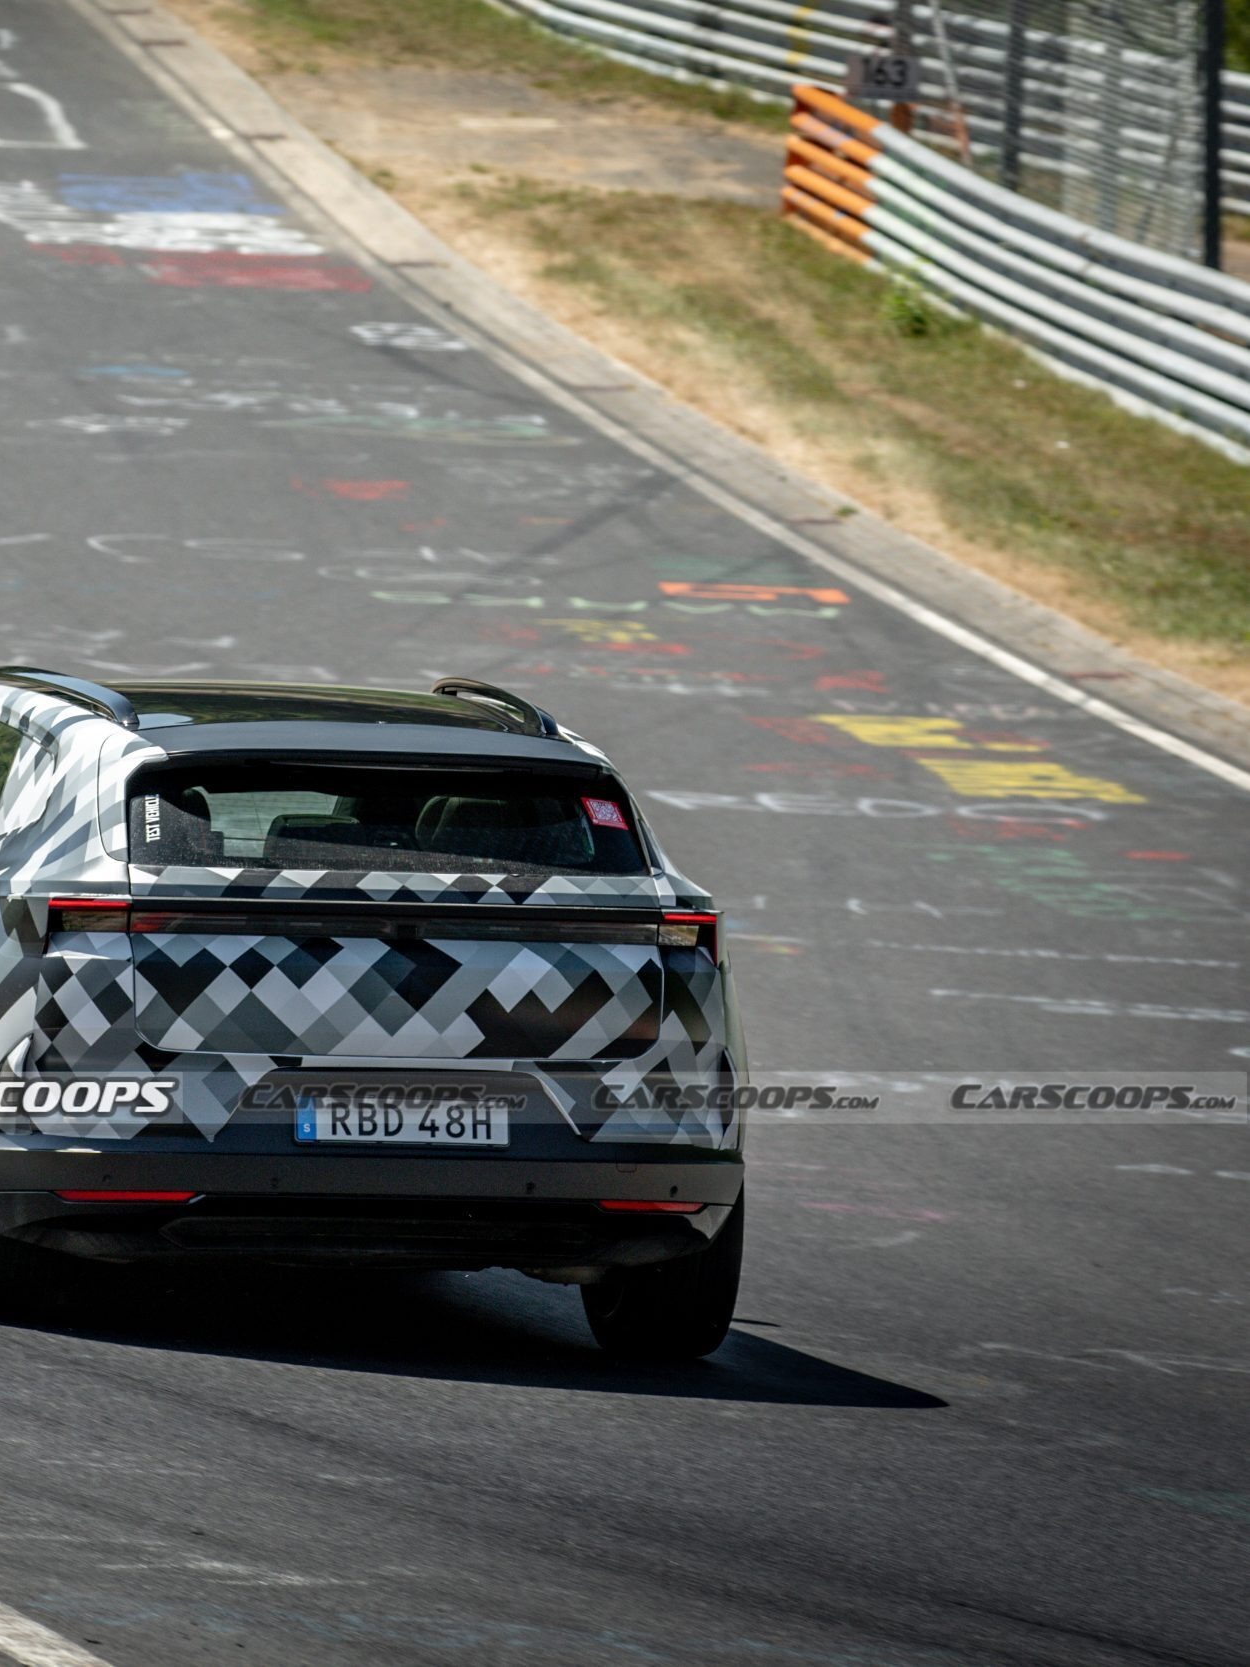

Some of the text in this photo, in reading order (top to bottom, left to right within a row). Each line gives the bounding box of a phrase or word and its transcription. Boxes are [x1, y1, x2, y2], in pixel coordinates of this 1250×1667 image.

[145, 794, 161, 843] TEST VEHICLE
[303, 1124, 311, 1133] S
[331, 1102, 492, 1140] RBD 48H
